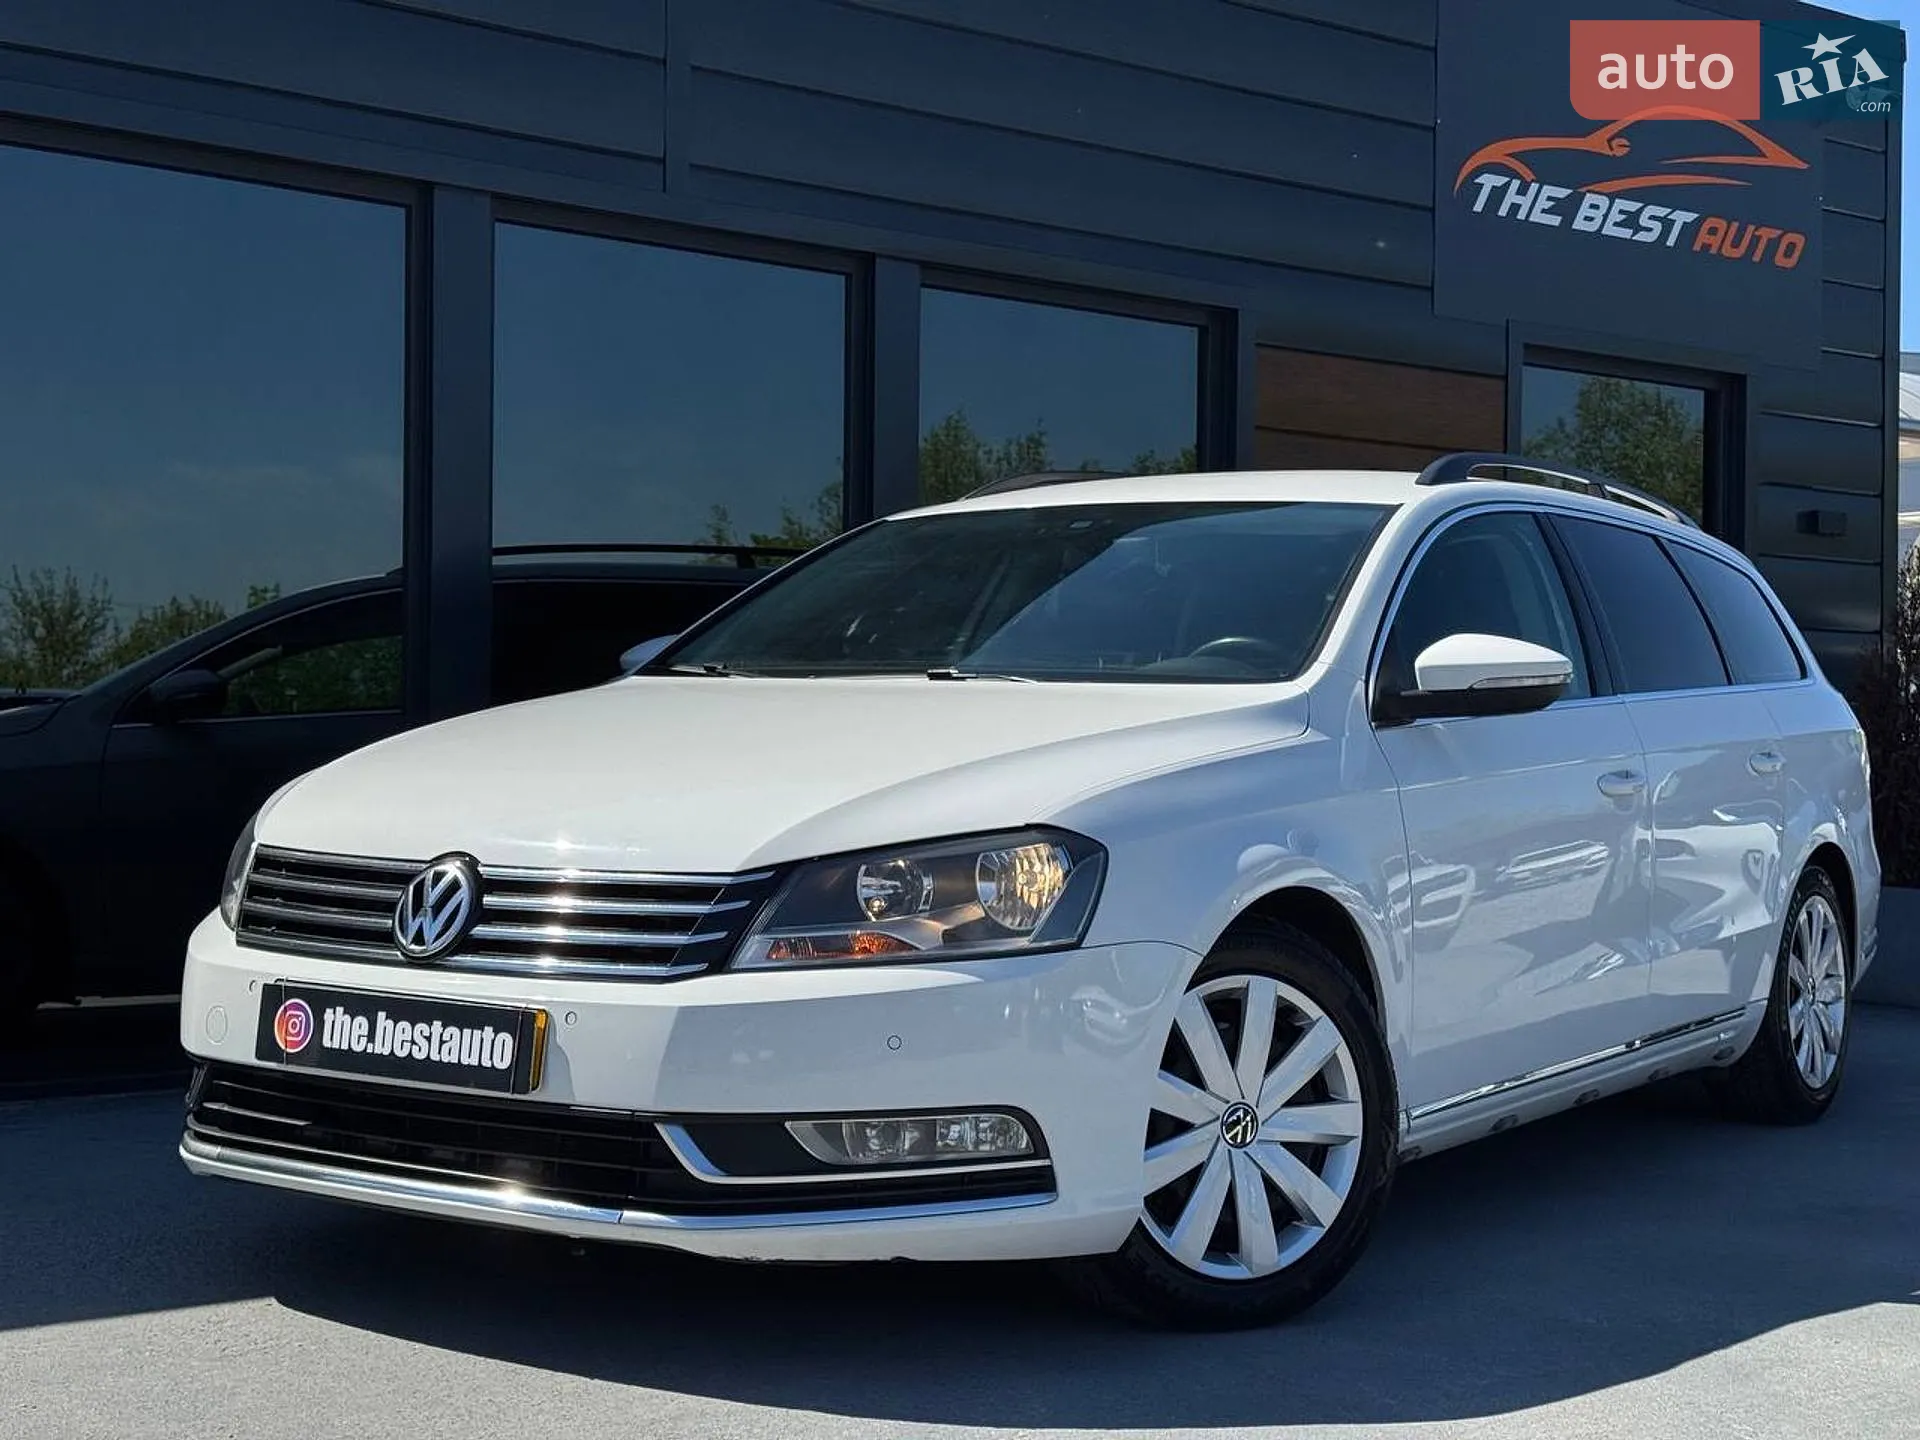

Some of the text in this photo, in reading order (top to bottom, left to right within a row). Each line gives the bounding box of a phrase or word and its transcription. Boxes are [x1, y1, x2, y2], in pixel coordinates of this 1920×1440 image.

[1472, 173, 1806, 269] THE BEST AUTO
[322, 1006, 514, 1070] the.bestauto
